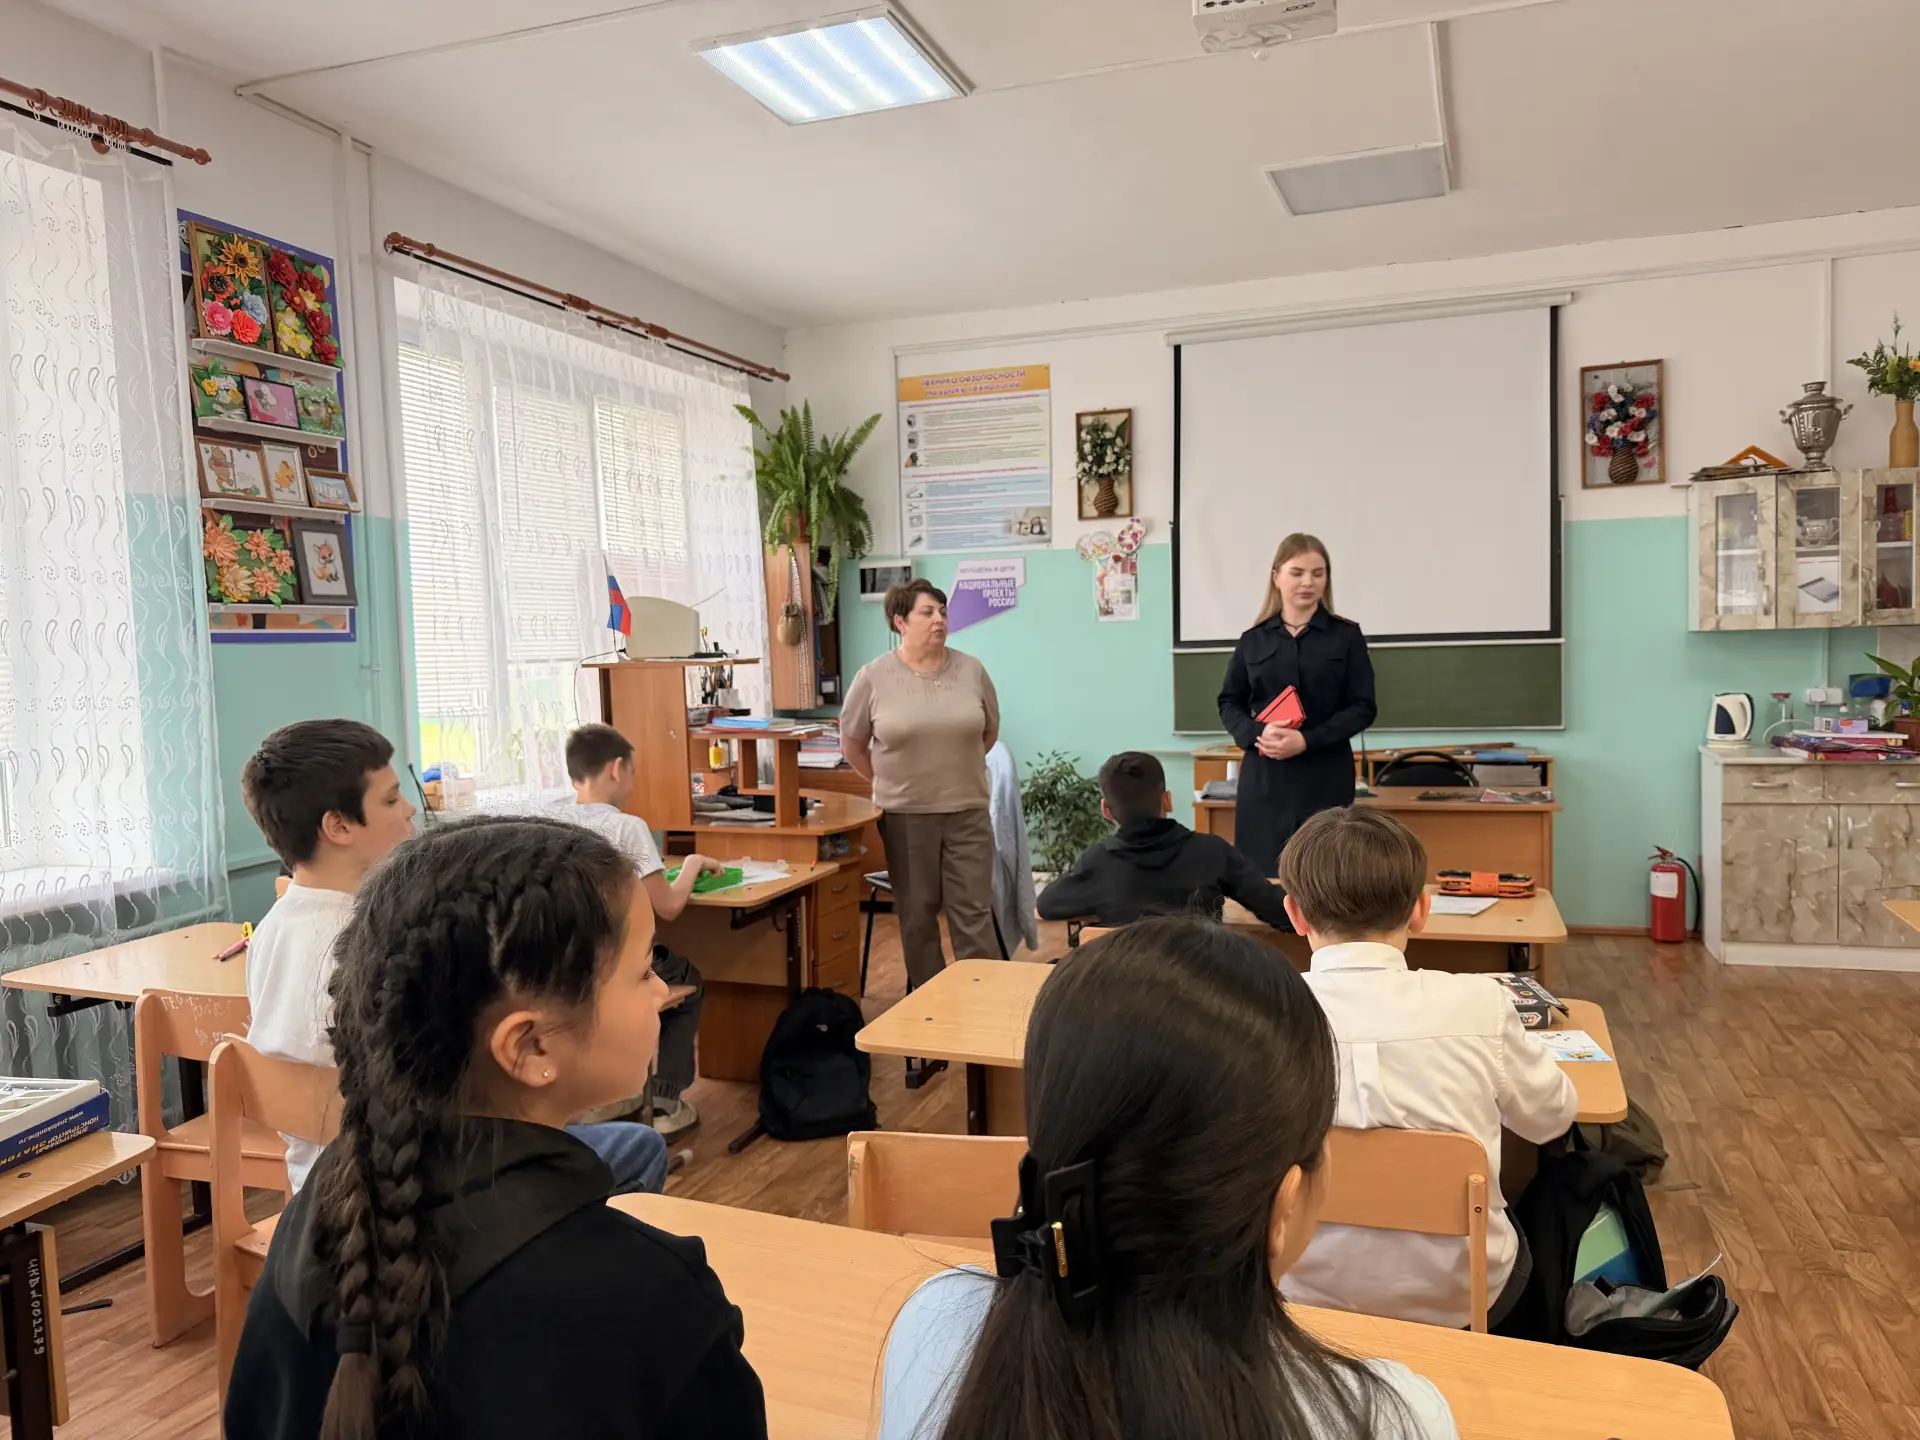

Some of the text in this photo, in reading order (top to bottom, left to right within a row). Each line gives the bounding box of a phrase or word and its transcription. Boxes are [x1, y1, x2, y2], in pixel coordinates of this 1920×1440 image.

[958, 370, 1027, 383] безопасности
[958, 579, 1015, 590] НАЦИОНАЛЬНЫЕ
[982, 588, 1015, 598] ПРОЕКТЫ
[988, 598, 1015, 608] РОССИИ
[18, 1110, 84, 1145] www.znatokonline.ru
